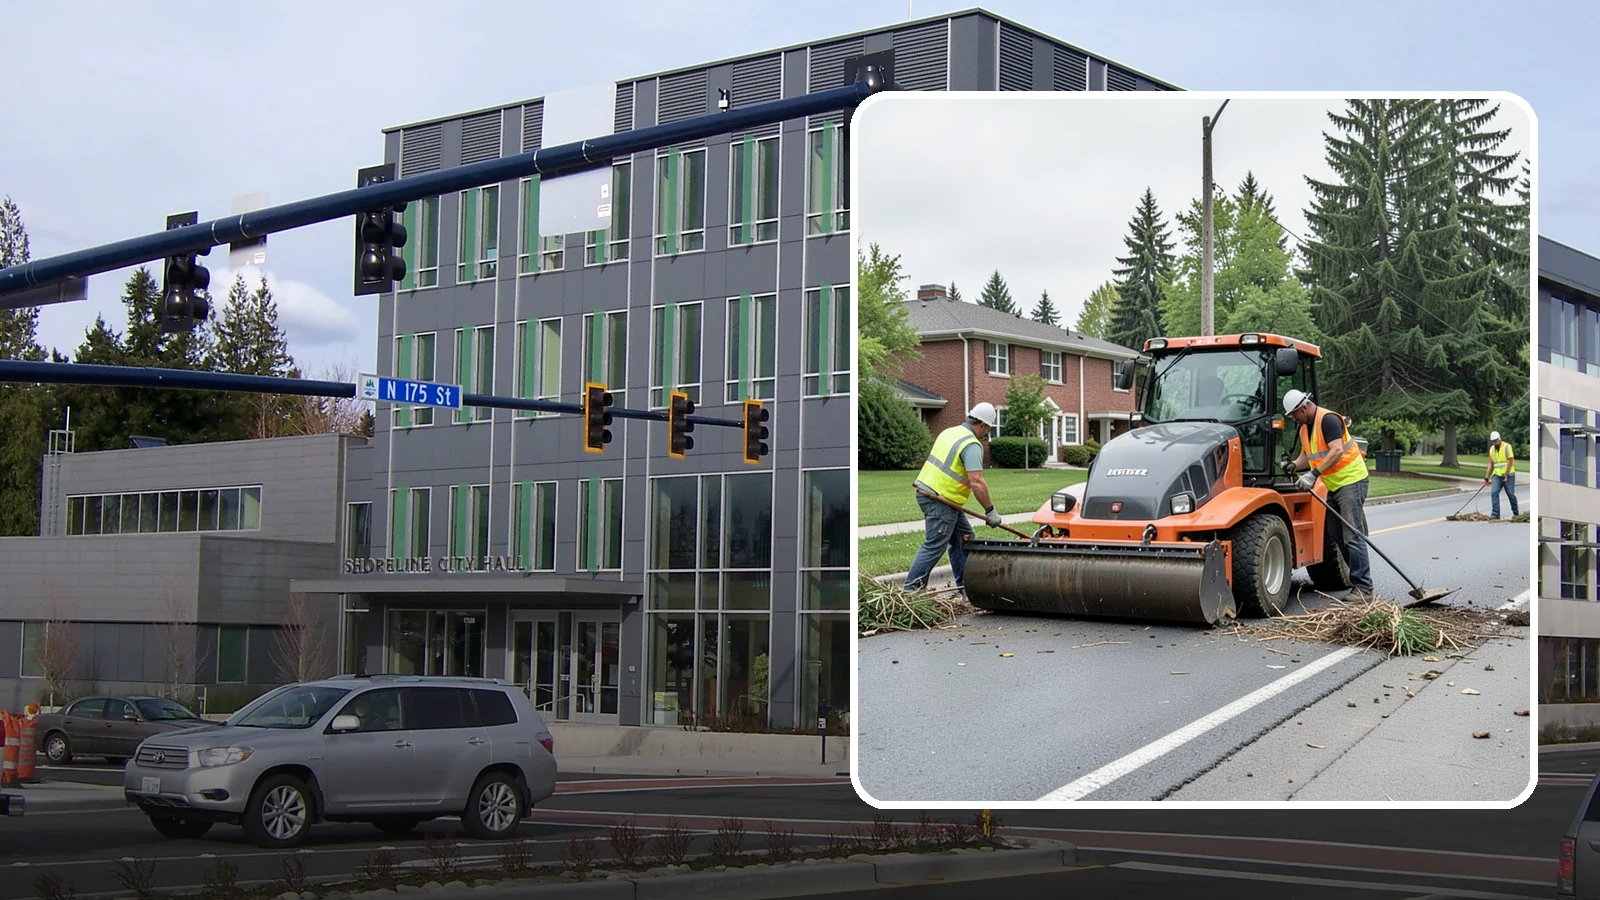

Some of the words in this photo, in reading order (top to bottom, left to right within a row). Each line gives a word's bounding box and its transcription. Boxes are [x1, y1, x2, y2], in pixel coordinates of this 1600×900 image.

[387, 380, 396, 400] N
[405, 382, 427, 403] 175
[436, 386, 451, 406] St
[343, 557, 432, 574] SHORELINE
[438, 556, 476, 572] CITY
[483, 556, 526, 572] HALL
